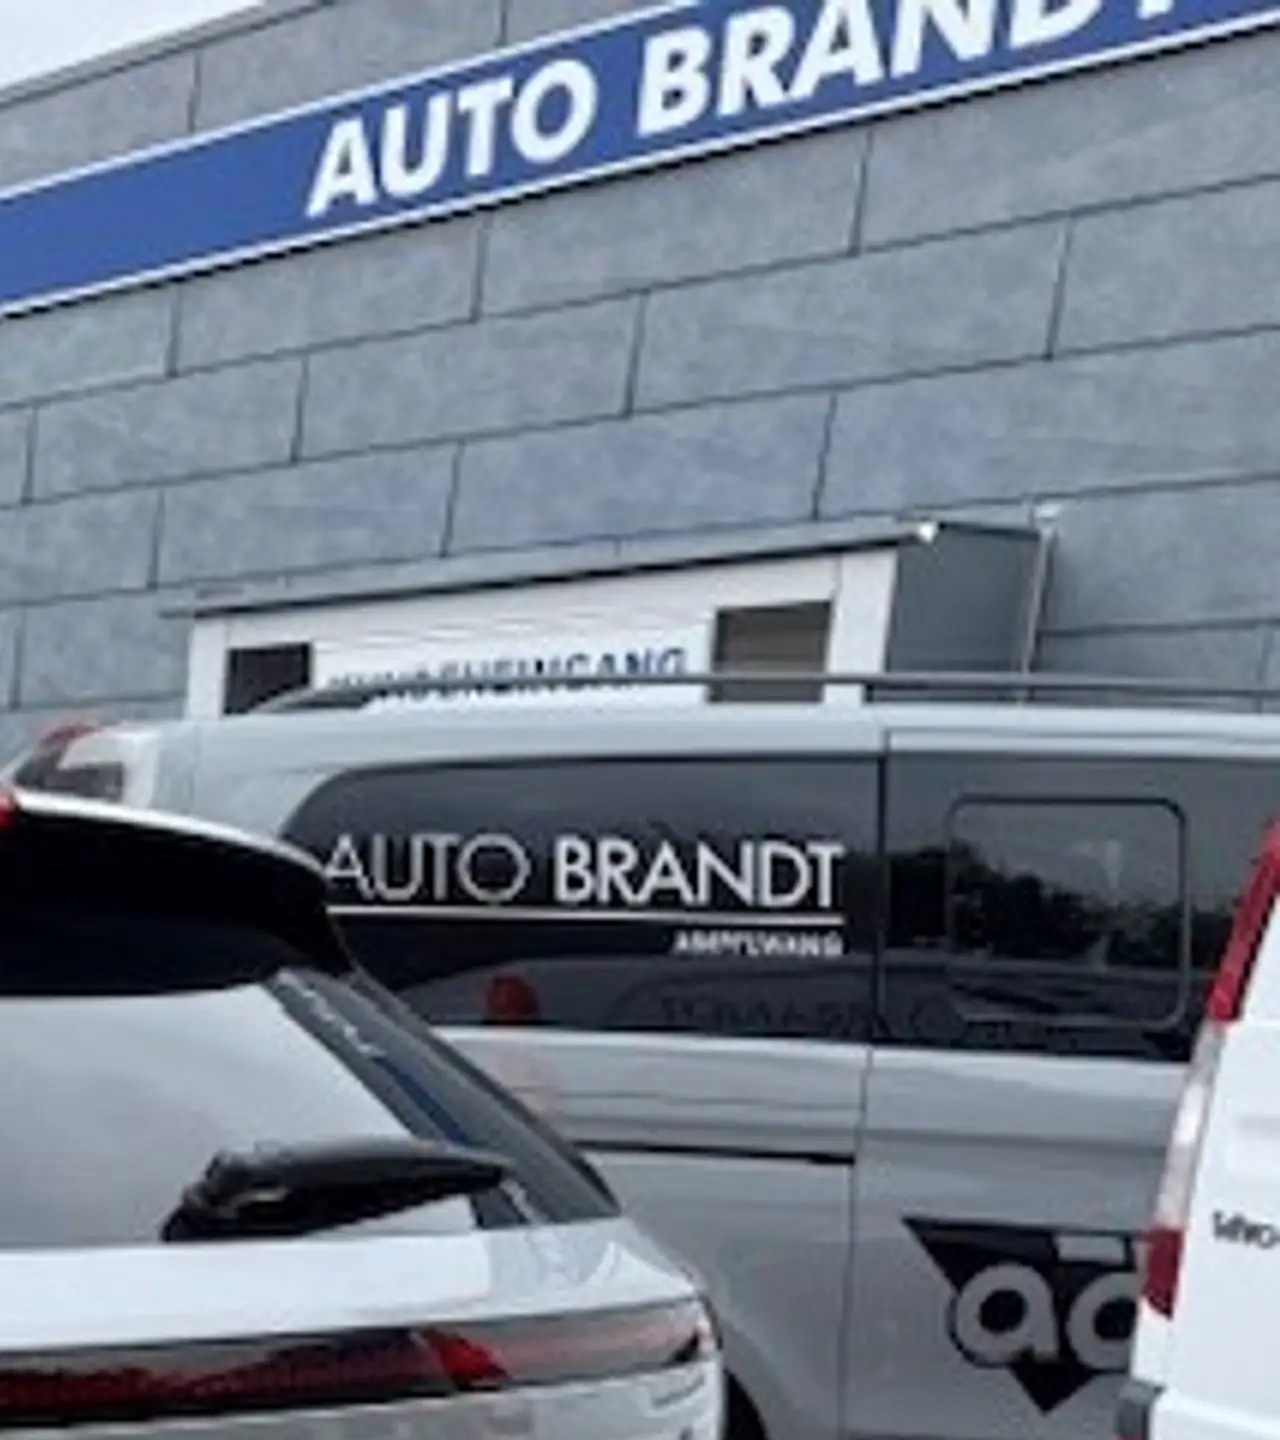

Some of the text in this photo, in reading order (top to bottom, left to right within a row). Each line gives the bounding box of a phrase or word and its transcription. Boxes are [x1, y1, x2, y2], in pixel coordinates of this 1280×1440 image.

[304, 0, 1178, 220] AUTO BRAN
[324, 832, 844, 909] AUTO BRANDT
